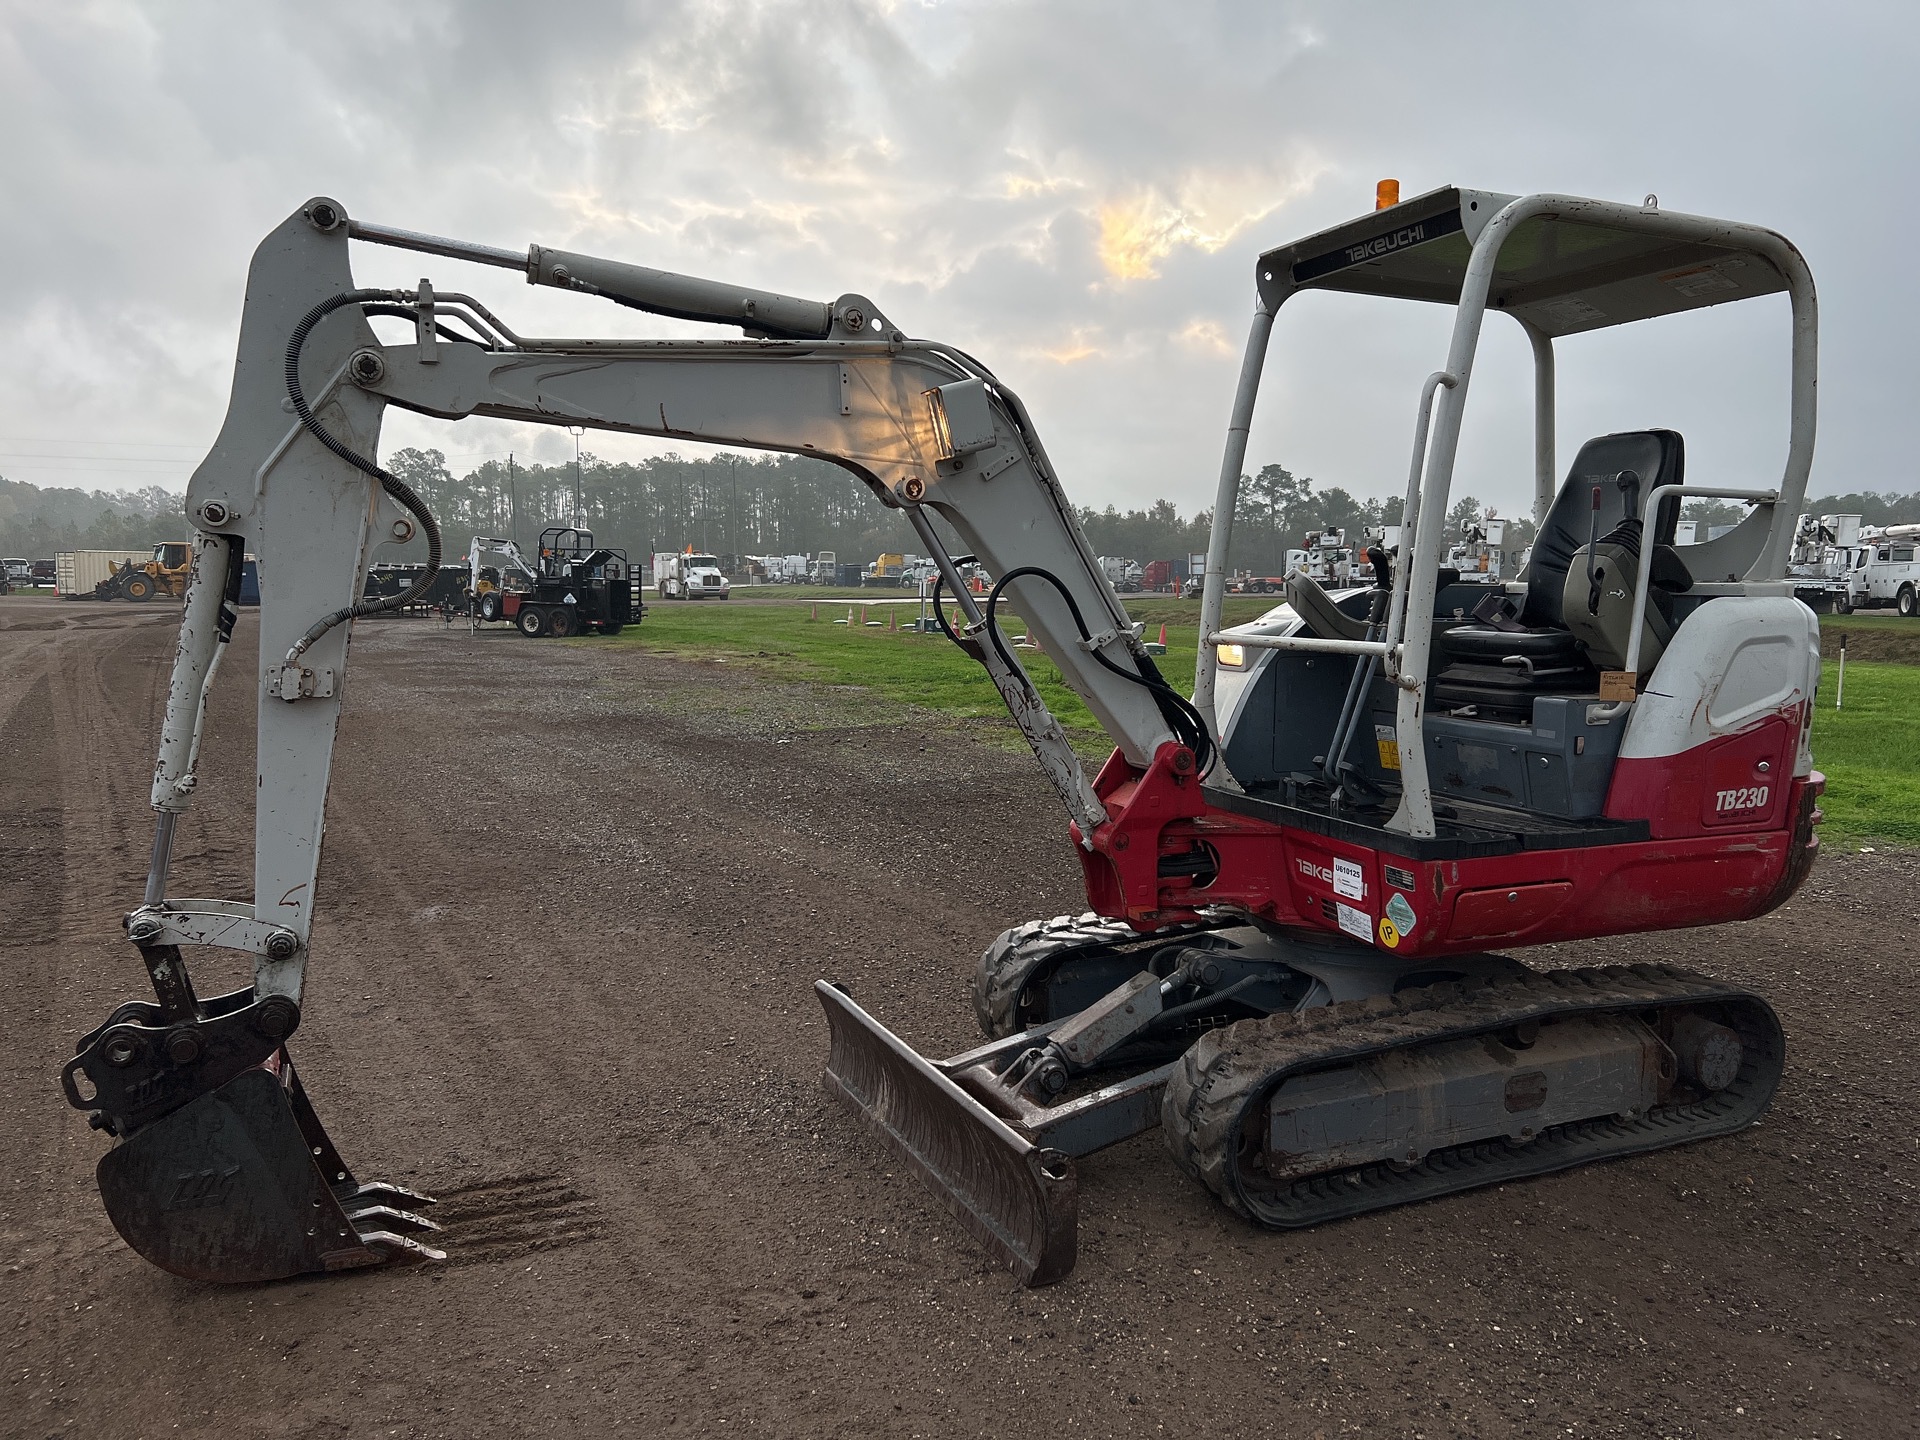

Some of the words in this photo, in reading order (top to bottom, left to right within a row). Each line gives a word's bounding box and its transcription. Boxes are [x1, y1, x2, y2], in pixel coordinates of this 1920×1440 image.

[1345, 225, 1424, 261] TAKEUCHI
[1716, 786, 1769, 811] TB230
[1335, 864, 1361, 879] U610125
[1382, 926, 1393, 941] IP
